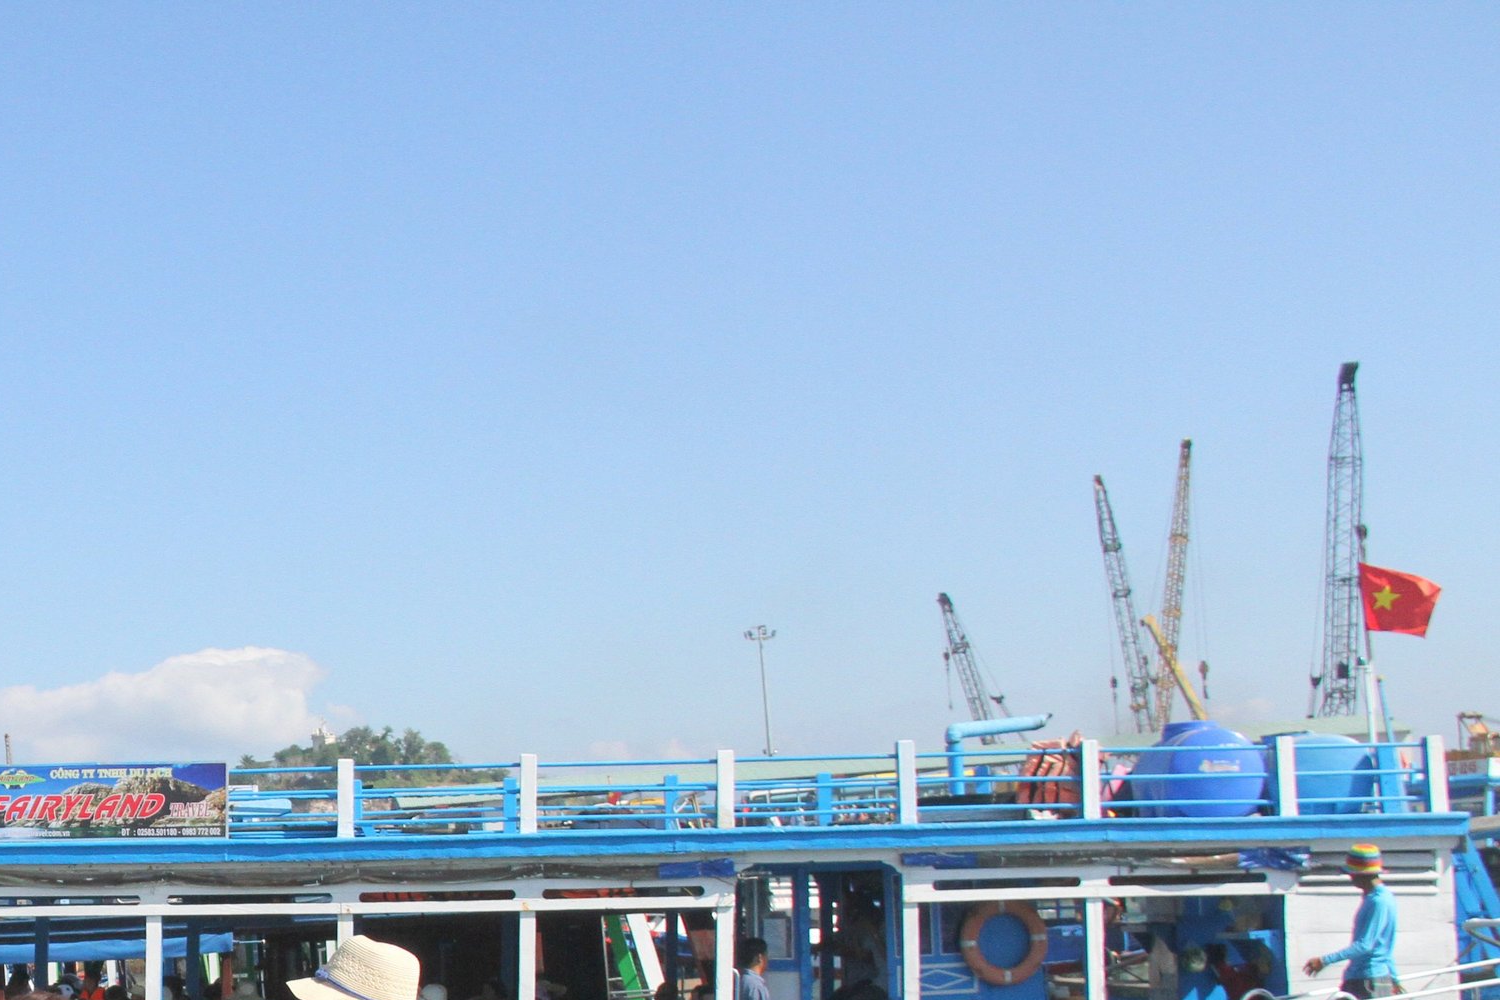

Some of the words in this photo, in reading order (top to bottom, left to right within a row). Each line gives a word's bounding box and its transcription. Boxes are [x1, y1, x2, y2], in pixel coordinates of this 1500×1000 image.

[49, 767, 80, 780] CÔNG
[81, 768, 96, 779] TY
[97, 767, 128, 779] TNHH
[128, 767, 145, 778] DU
[169, 801, 212, 818] TRAVEL
